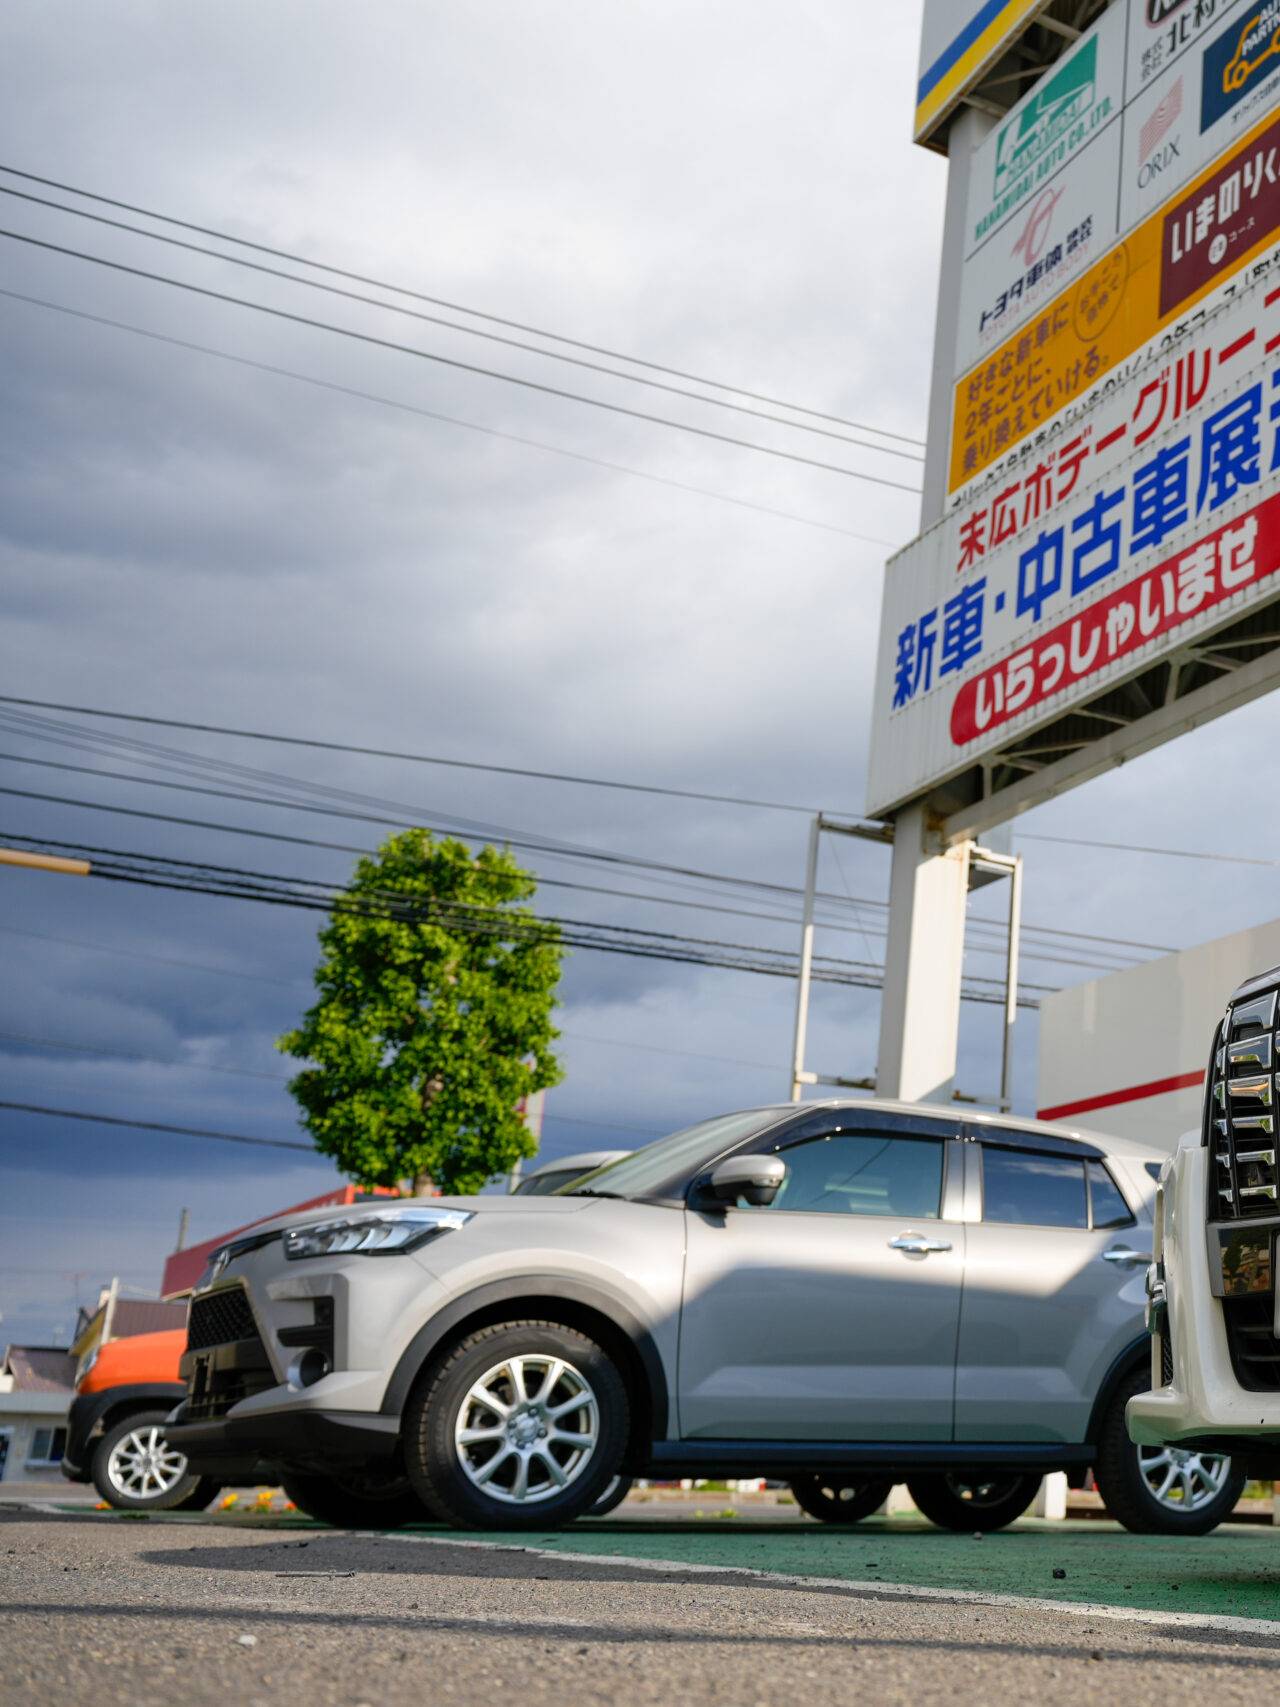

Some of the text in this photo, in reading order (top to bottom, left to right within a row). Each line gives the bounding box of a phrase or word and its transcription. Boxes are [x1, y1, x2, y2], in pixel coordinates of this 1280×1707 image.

[1137, 134, 1182, 189] ORIX
[974, 514, 1258, 730] いらっしゃいませ
